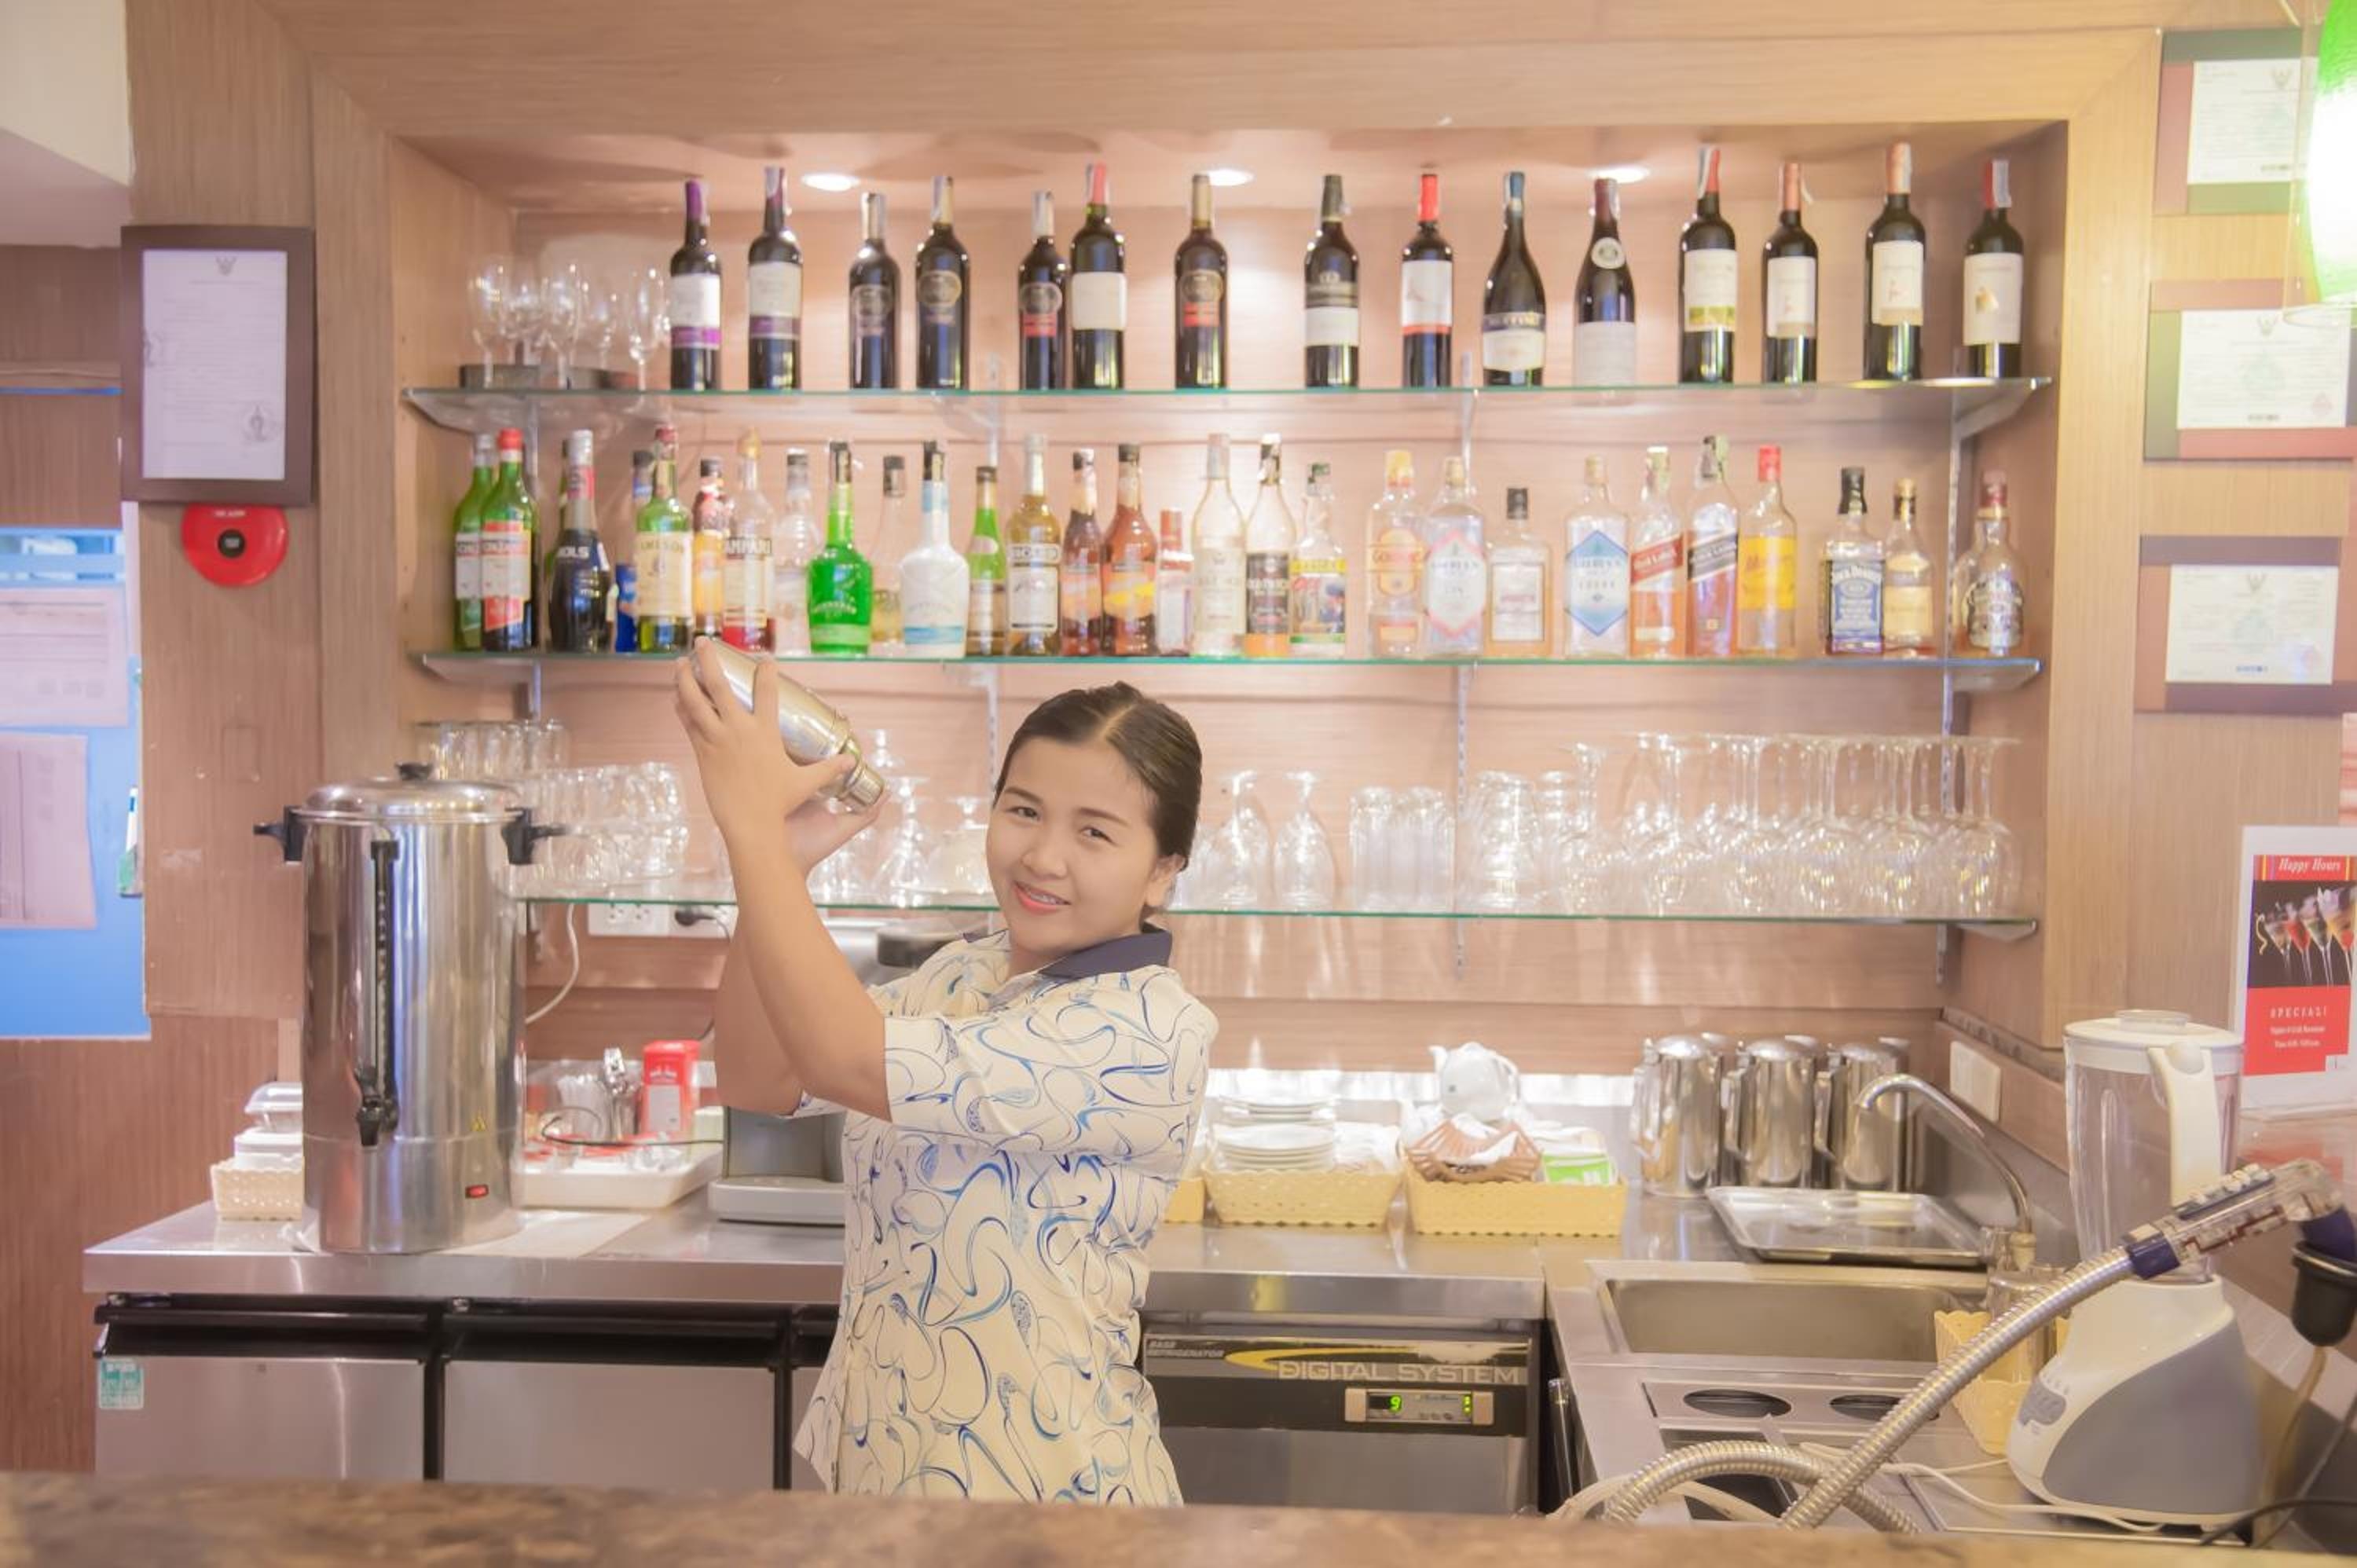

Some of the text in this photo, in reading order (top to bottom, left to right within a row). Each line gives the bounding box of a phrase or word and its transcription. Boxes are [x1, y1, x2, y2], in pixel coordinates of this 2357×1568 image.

[723, 538, 772, 555] AMPARI
[2278, 856, 2341, 874] Happy Hours
[1278, 1360, 1520, 1384] DIGITAL SYSTEM
[1390, 1395, 1402, 1412] 9
